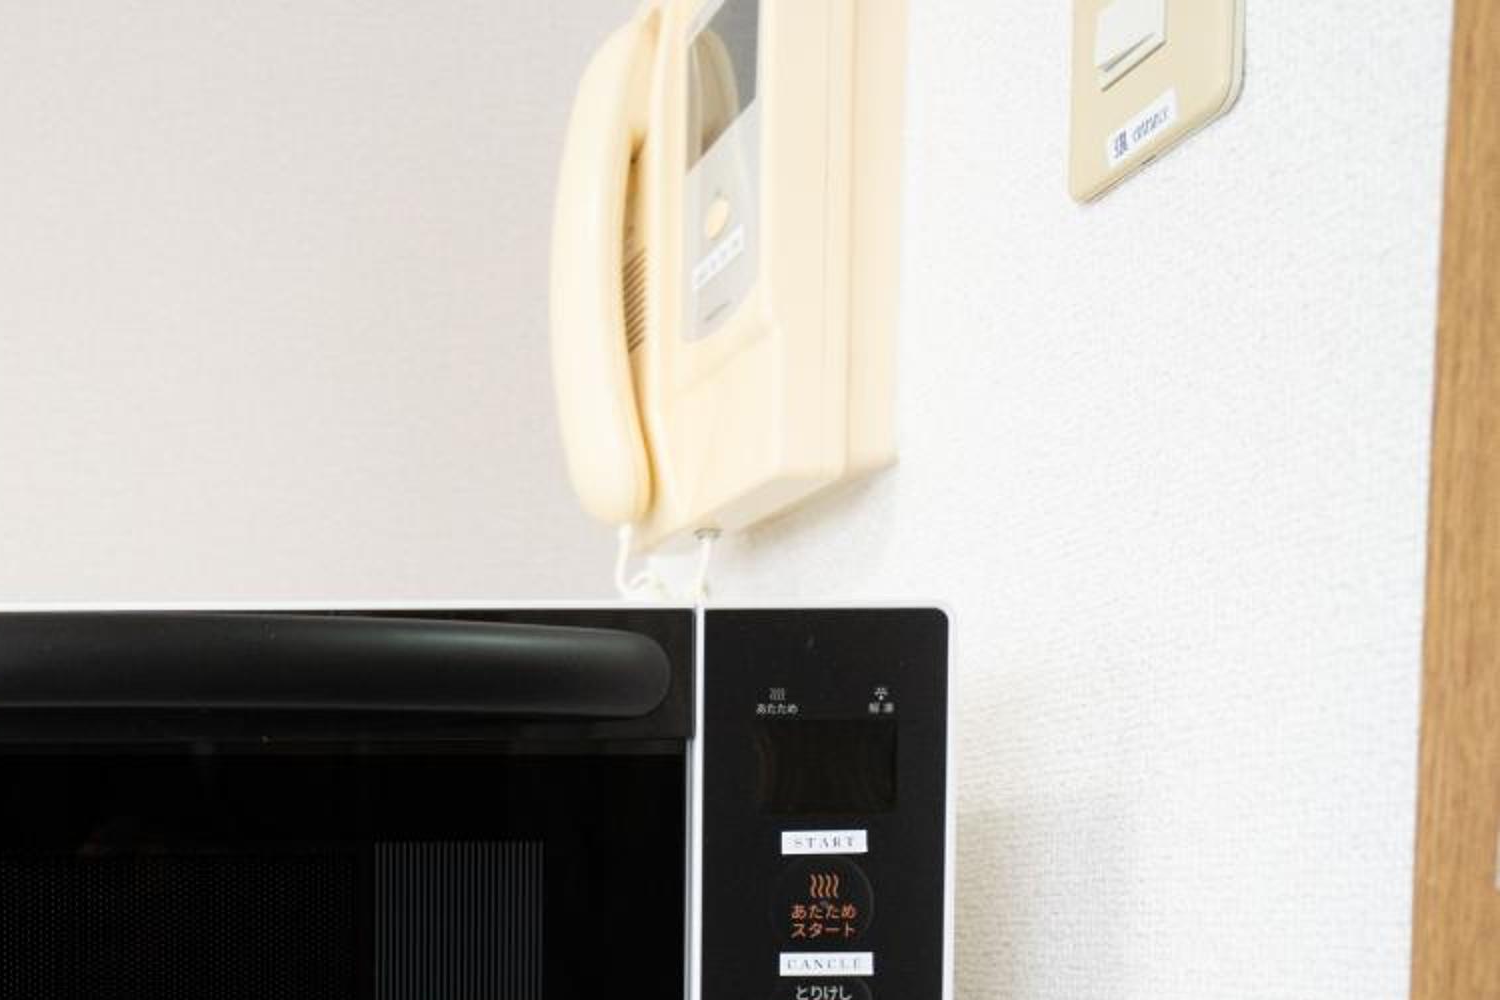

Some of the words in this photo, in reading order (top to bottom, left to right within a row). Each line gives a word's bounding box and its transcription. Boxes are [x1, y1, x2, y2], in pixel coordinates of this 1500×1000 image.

[792, 836, 856, 849] START
[791, 904, 857, 920] あたため
[791, 923, 856, 939] スタート
[787, 957, 862, 971] CANCLE
[796, 985, 852, 1000] とりけし
